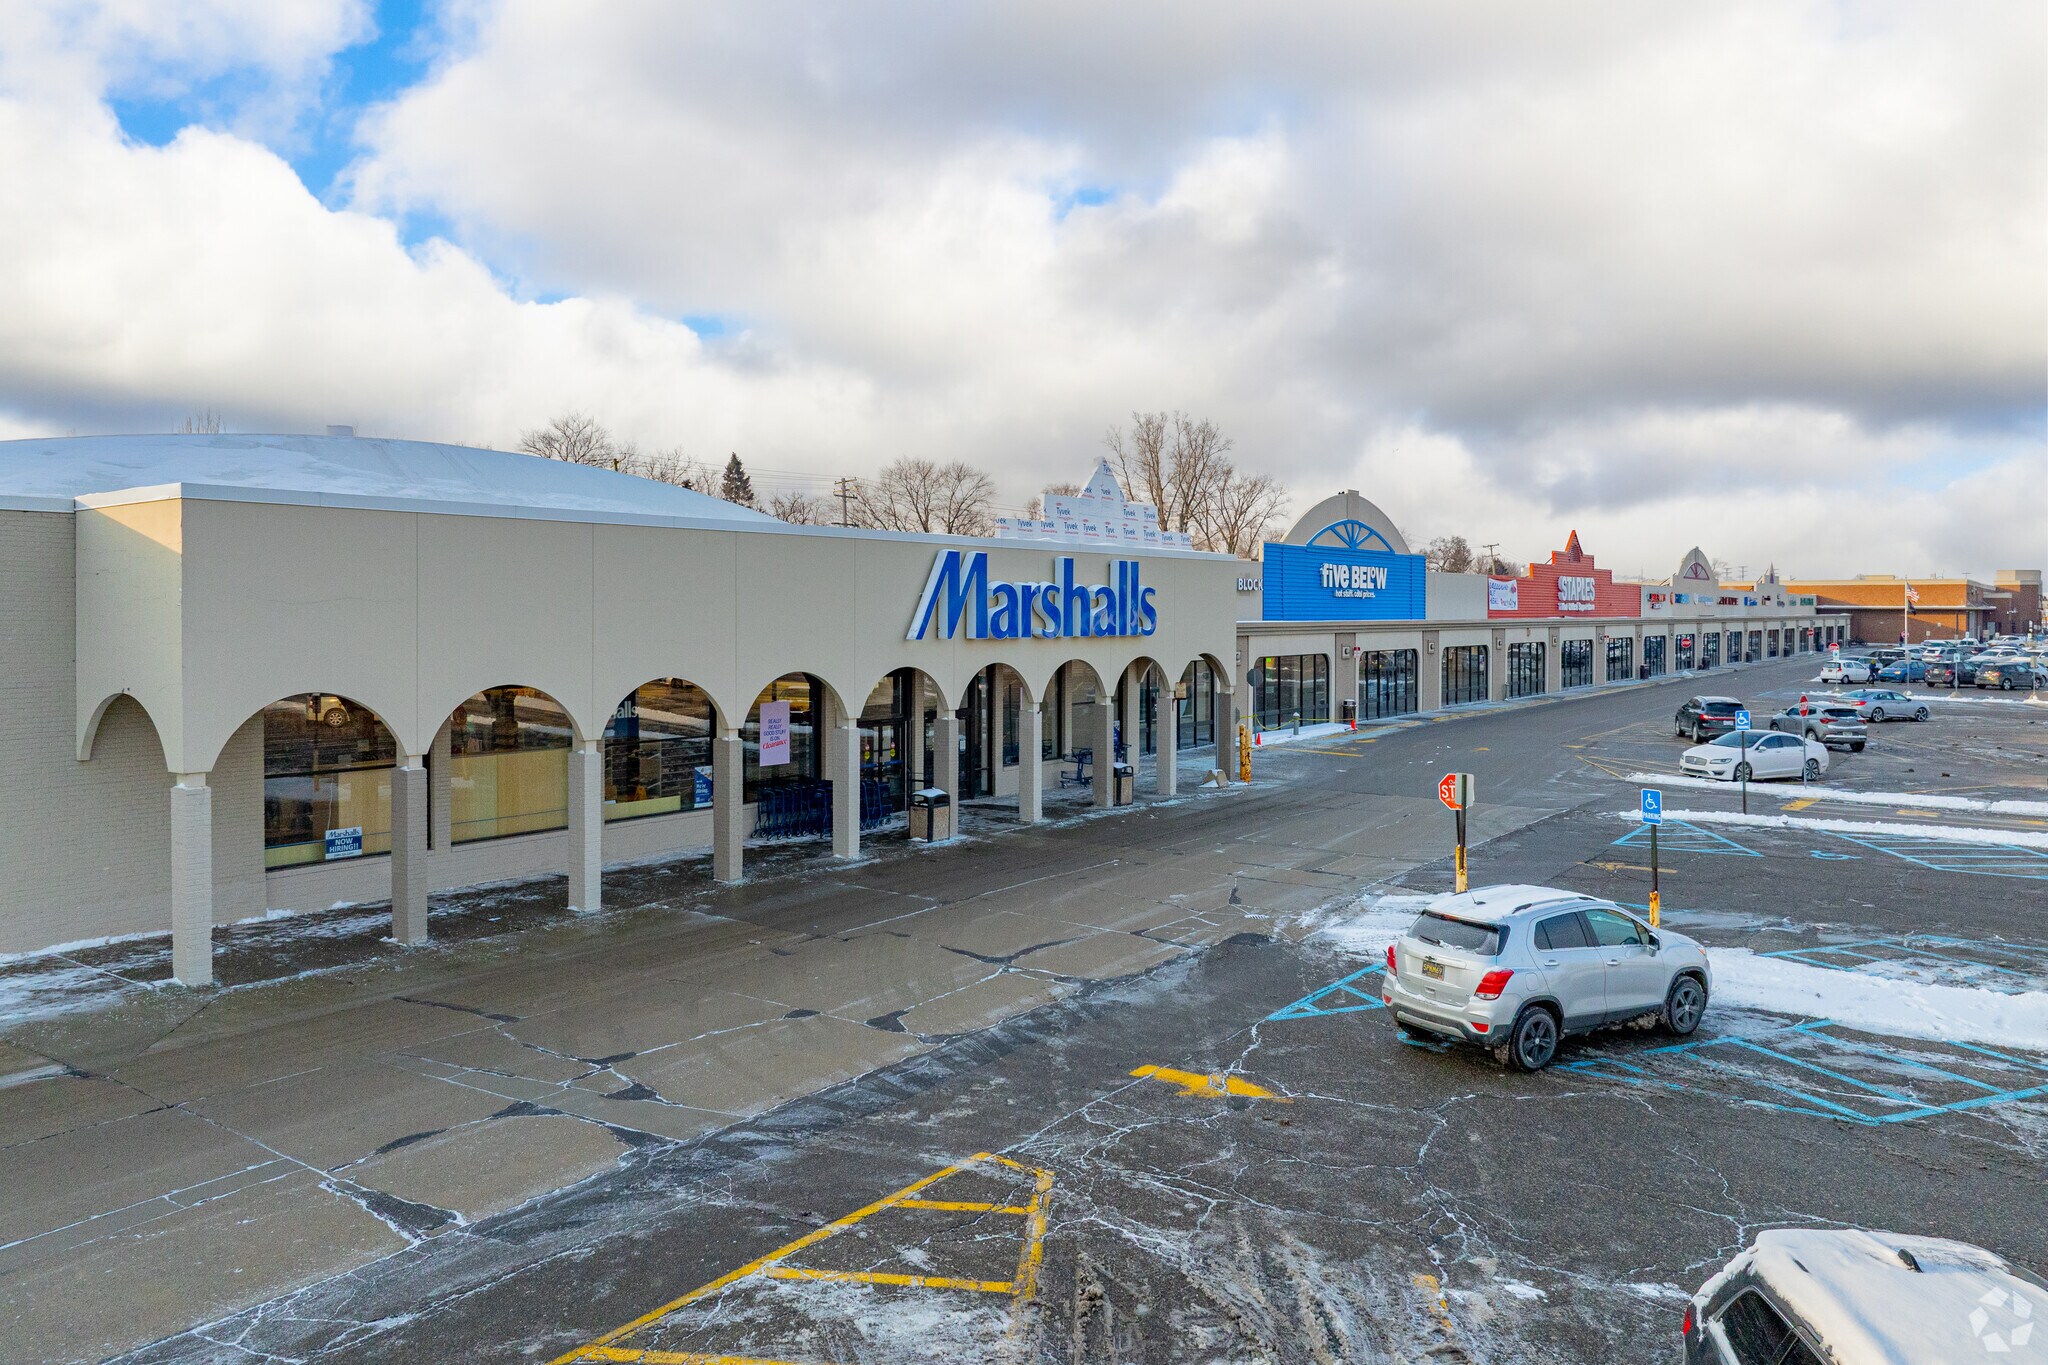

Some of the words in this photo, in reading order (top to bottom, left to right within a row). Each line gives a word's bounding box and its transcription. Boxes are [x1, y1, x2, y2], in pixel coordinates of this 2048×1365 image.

[1056, 507, 1071, 516] Tyvek
[1123, 508, 1136, 518] Tyvek
[1144, 511, 1156, 520] Tyvek
[1017, 519, 1033, 528] Tyvek
[1040, 520, 1055, 529] Tyvek
[1064, 522, 1079, 531] Tyvek
[1083, 524, 1097, 532] Tyvek
[1123, 527, 1136, 536] Tyvek
[1143, 530, 1156, 539] Tyvek
[1162, 534, 1174, 542] Tyvek
[1320, 563, 1349, 588] five
[1352, 566, 1387, 590] BELOW
[1238, 578, 1263, 591] BLOCK
[1558, 576, 1595, 601] STAPLES
[906, 549, 1157, 640] Marshalls
[1335, 589, 1343, 598] hot
[1441, 784, 1456, 799] ST
[328, 829, 359, 838] Marshalls
[329, 843, 359, 853] HIRING!!
